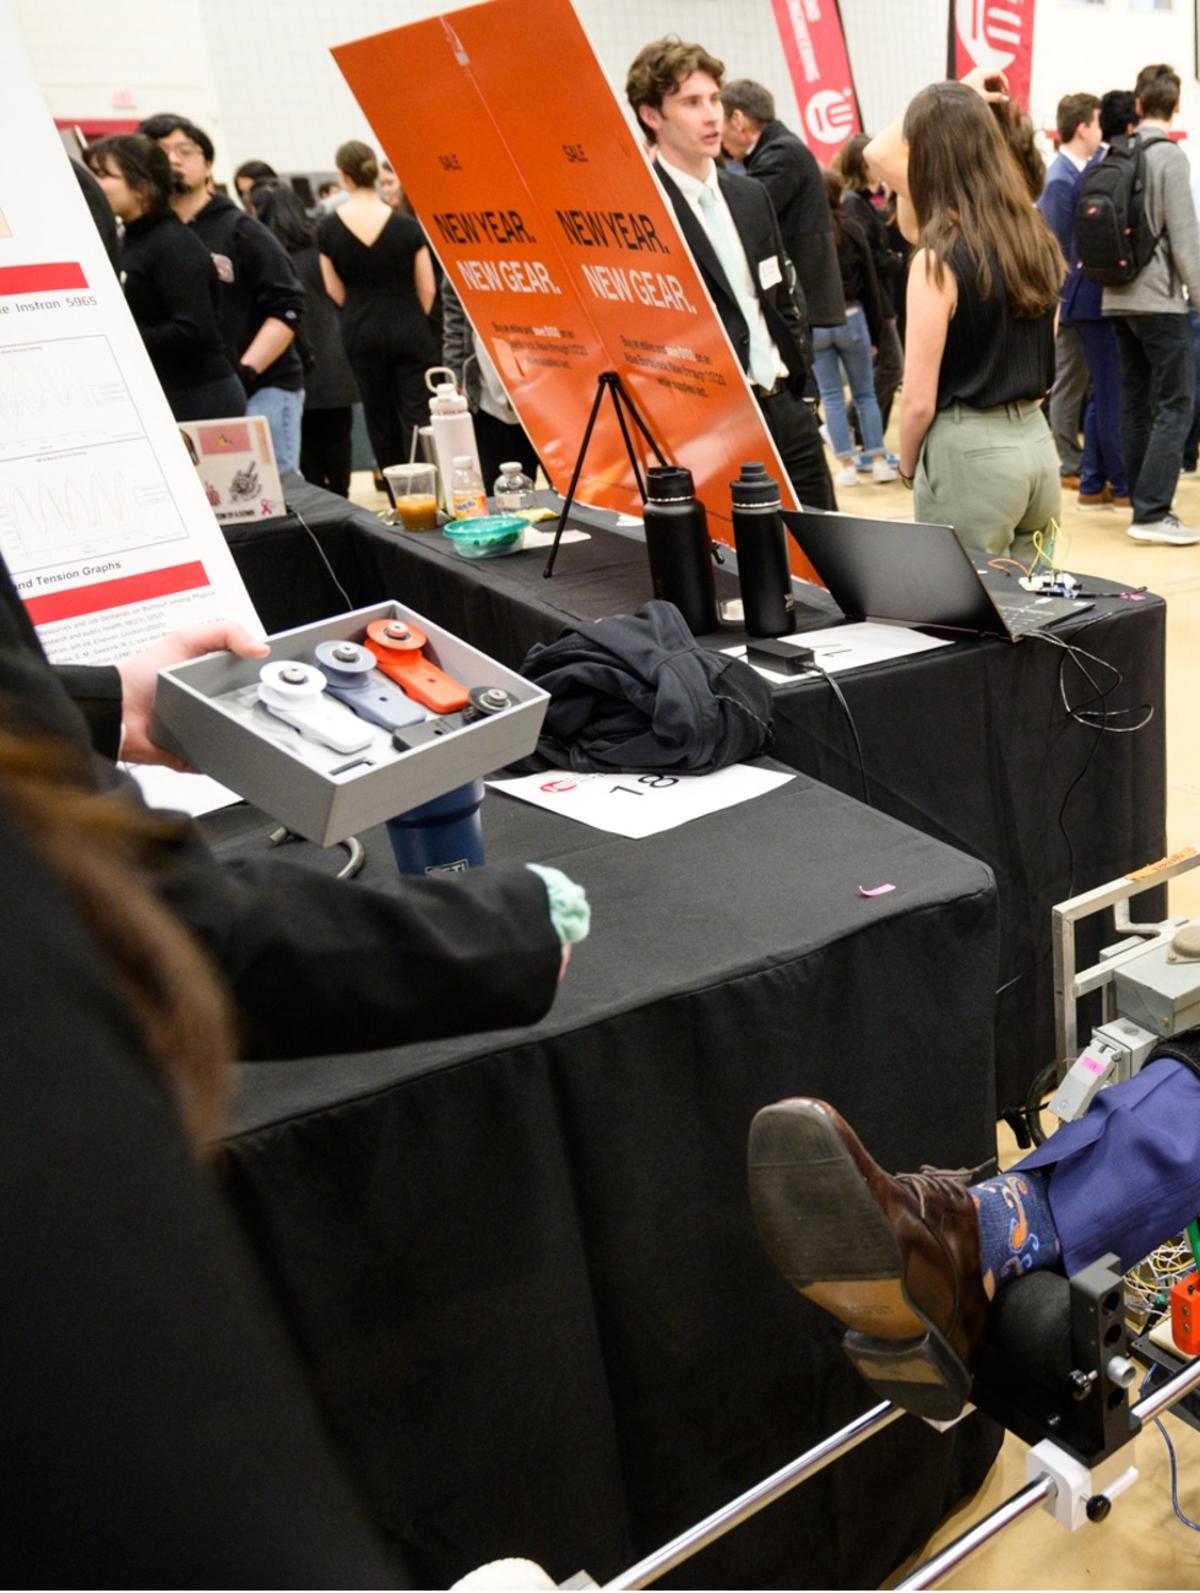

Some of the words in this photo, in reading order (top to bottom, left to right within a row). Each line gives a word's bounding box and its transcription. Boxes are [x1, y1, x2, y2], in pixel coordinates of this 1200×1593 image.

[438, 154, 462, 171] SALE
[562, 144, 589, 163] SALE
[432, 212, 481, 244] NEW
[473, 210, 537, 244] YEAR.
[556, 210, 609, 248] NEW
[599, 211, 671, 254] YEAR.
[456, 260, 504, 292] NEW
[499, 260, 562, 295] GEAR.
[581, 264, 635, 303] NEW
[629, 268, 698, 314] GEAR.
[15, 300, 61, 313] Instron
[65, 296, 98, 308] 5965
[37, 570, 80, 586] Tension
[83, 561, 122, 576] Graphs
